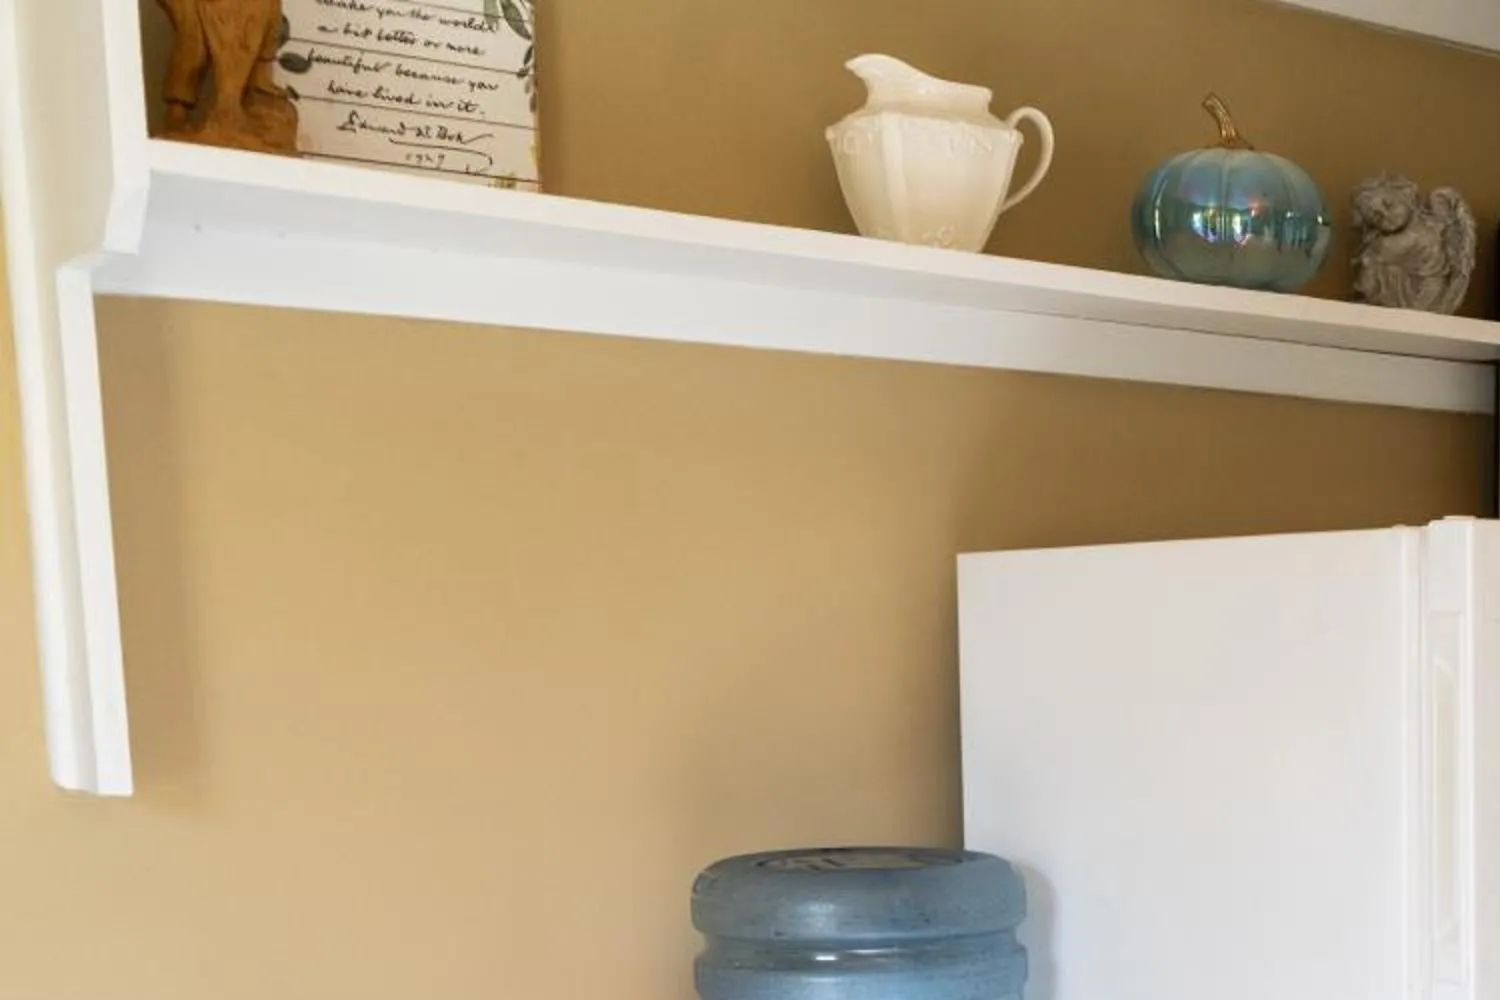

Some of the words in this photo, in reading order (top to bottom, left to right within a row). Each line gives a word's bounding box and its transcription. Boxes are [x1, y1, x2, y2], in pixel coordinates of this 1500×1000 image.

[343, 22, 373, 39] bit
[377, 28, 417, 45] better
[423, 39, 443, 48] or
[445, 42, 485, 55] more
[307, 48, 391, 74] beautiful
[395, 63, 464, 85] because
[468, 79, 499, 93] you
[328, 80, 369, 98] have
[372, 85, 421, 105] lived
[425, 93, 455, 109] in
